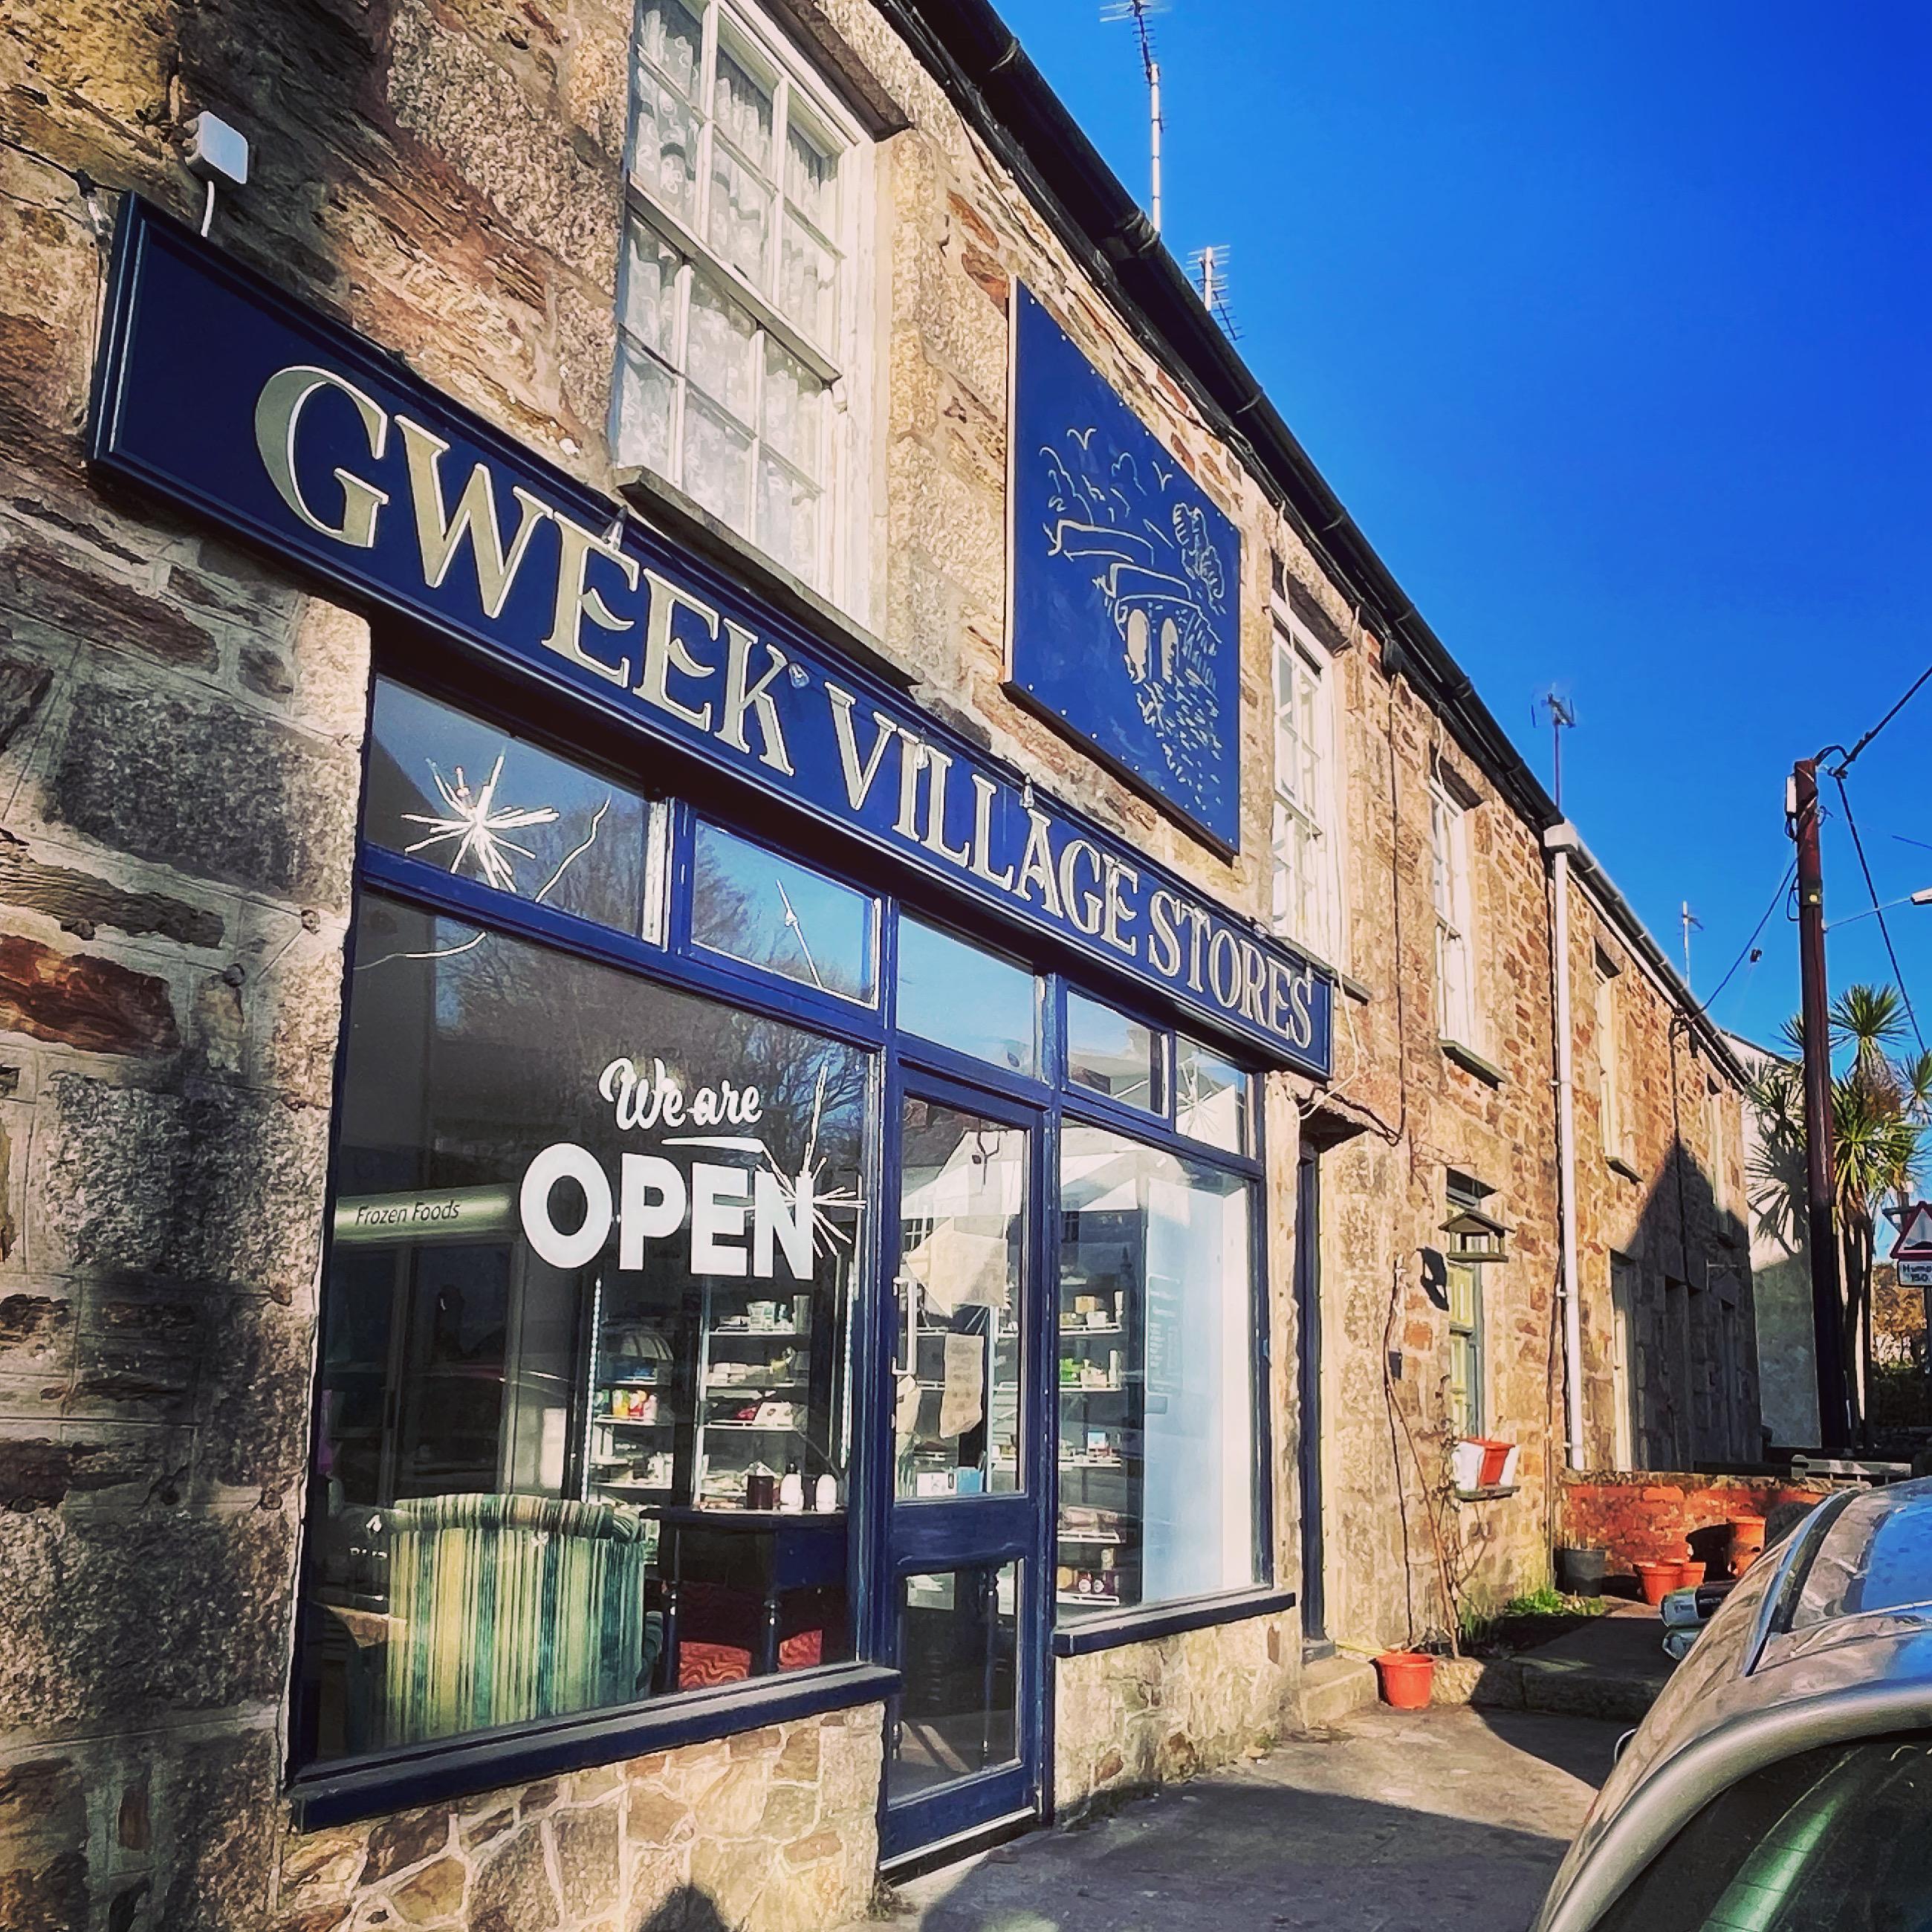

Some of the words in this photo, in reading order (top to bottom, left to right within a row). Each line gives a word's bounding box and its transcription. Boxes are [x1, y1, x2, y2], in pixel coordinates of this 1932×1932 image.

[253, 365, 795, 777] GWEEK
[823, 681, 1139, 958] VILLAGE
[1147, 889, 1314, 1049] STORES
[598, 1057, 687, 1131] We
[688, 1080, 764, 1127] are
[356, 1205, 408, 1225] Frozen
[412, 1199, 460, 1222] Foods
[519, 1141, 814, 1280] OPEN
